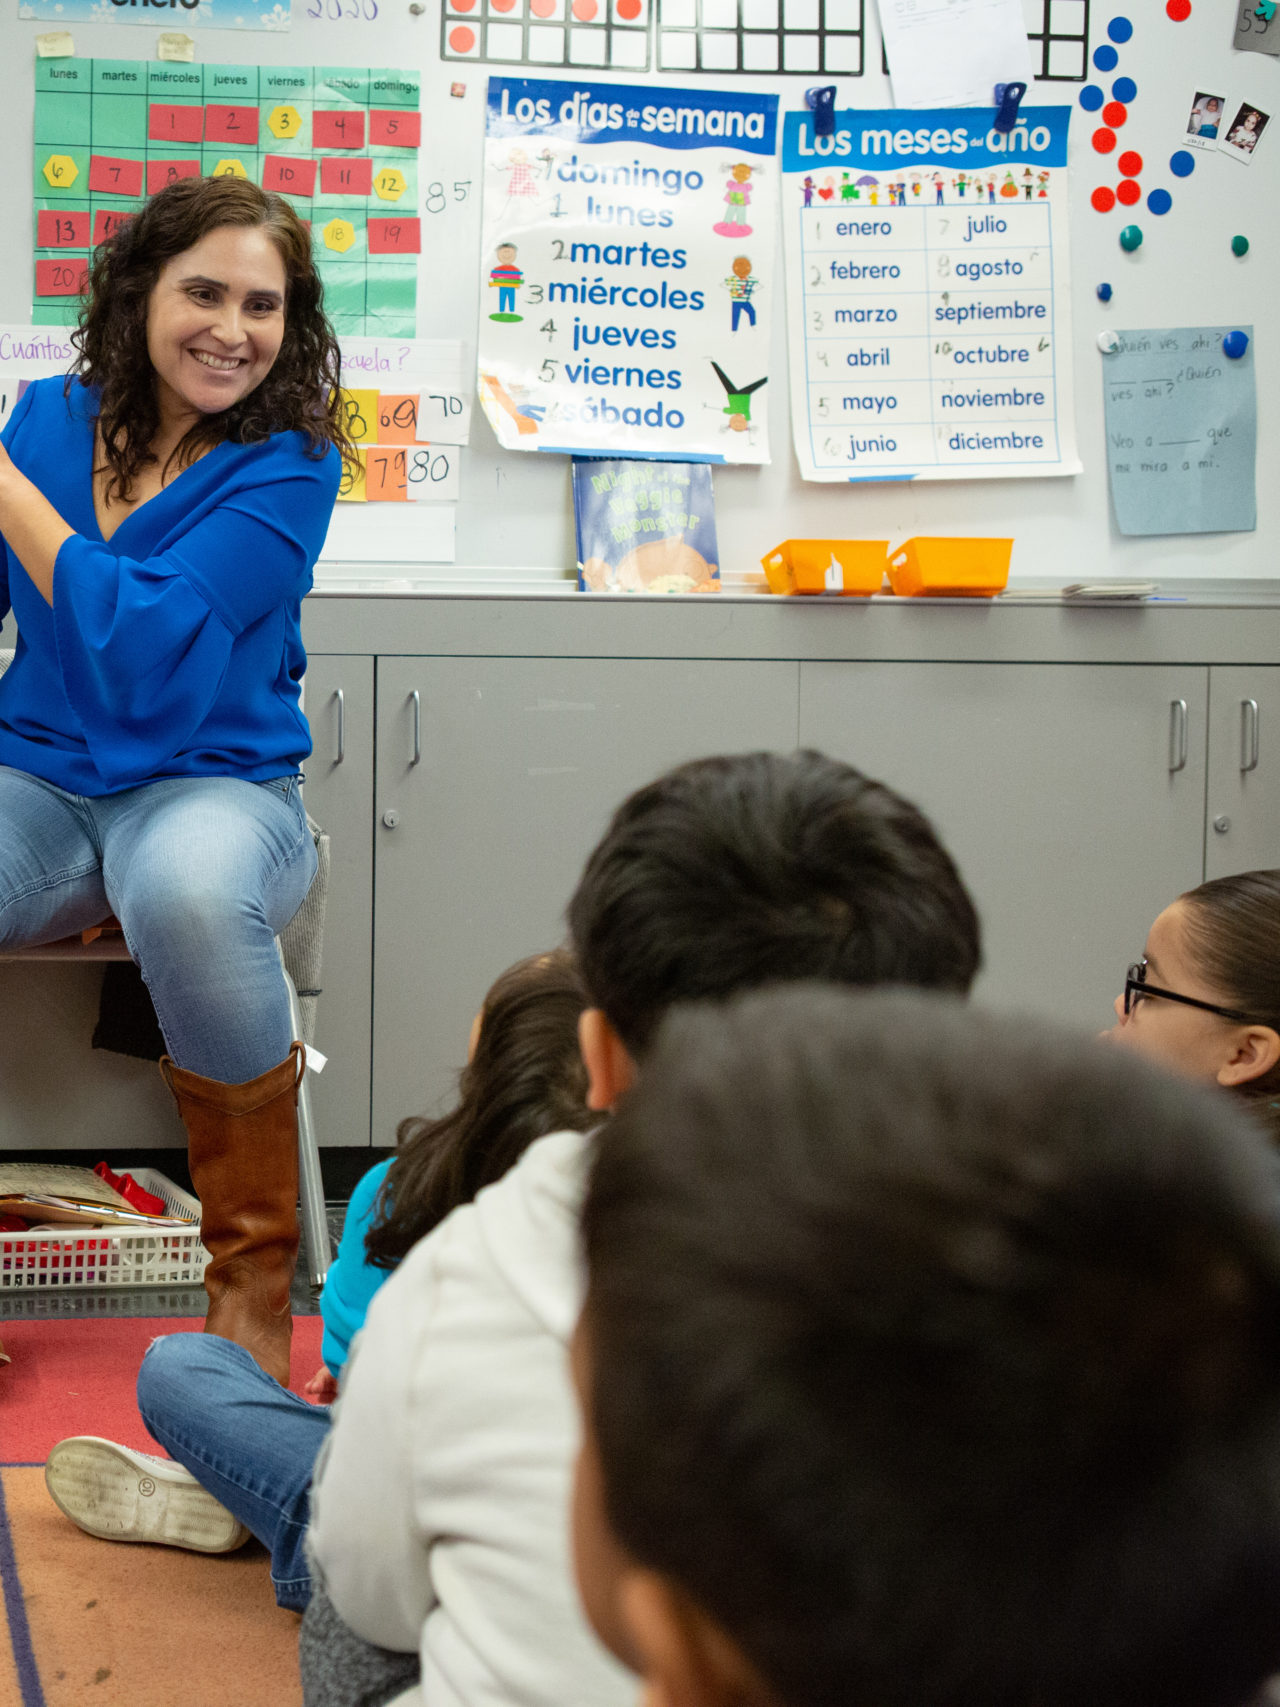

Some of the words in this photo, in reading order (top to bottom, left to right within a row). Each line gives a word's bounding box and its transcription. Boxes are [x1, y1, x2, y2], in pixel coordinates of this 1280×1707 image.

[50, 68, 78, 80] lunes
[102, 70, 137, 81] martes
[150, 70, 200, 84] miércoles
[213, 74, 248, 87] jueves
[267, 75, 305, 87] viernes
[373, 79, 419, 92] domingo
[170, 113, 175, 129] 1
[226, 113, 241, 130] 2
[279, 112, 290, 129] 3
[334, 117, 346, 138] 4
[386, 119, 399, 135] 5
[500, 88, 551, 123] Los
[559, 91, 624, 130] días
[641, 105, 765, 140] semana
[861, 127, 969, 155] meses
[970, 136, 984, 147] del
[985, 118, 1051, 153] año
[109, 167, 121, 182] 7
[279, 168, 295, 181] 10
[340, 170, 351, 184] 11
[380, 178, 397, 192] 12
[557, 154, 704, 196] domingo
[425, 181, 472, 214] 85
[549, 193, 568, 218] 1
[587, 196, 675, 229] lunes
[55, 218, 76, 243] 13
[330, 227, 345, 241] 18
[383, 225, 402, 243] 19
[836, 221, 892, 236] enero
[962, 215, 1007, 242] julio
[551, 240, 570, 261] 2
[570, 242, 687, 269] martes
[52, 267, 74, 287] 20
[829, 260, 901, 280] febrero
[955, 258, 1024, 281] agosto
[524, 284, 545, 305] 3
[548, 276, 705, 311] miércoles
[834, 305, 898, 323] marzo
[935, 300, 1047, 325] septiembre
[539, 318, 558, 343] 4
[573, 317, 677, 351] jueves
[846, 347, 890, 367] abril
[954, 345, 1030, 364] octubre
[537, 358, 559, 383] 5
[564, 357, 682, 390] viernes
[428, 395, 463, 418] 70
[842, 395, 898, 414] mayo
[941, 388, 1046, 408] noviembre
[563, 396, 685, 429] sábado
[847, 434, 897, 460] junio
[948, 432, 1044, 451] diciembre
[1207, 427, 1233, 446] que
[408, 450, 450, 483] 80
[591, 465, 654, 495] Night
[610, 512, 700, 544] Monster
